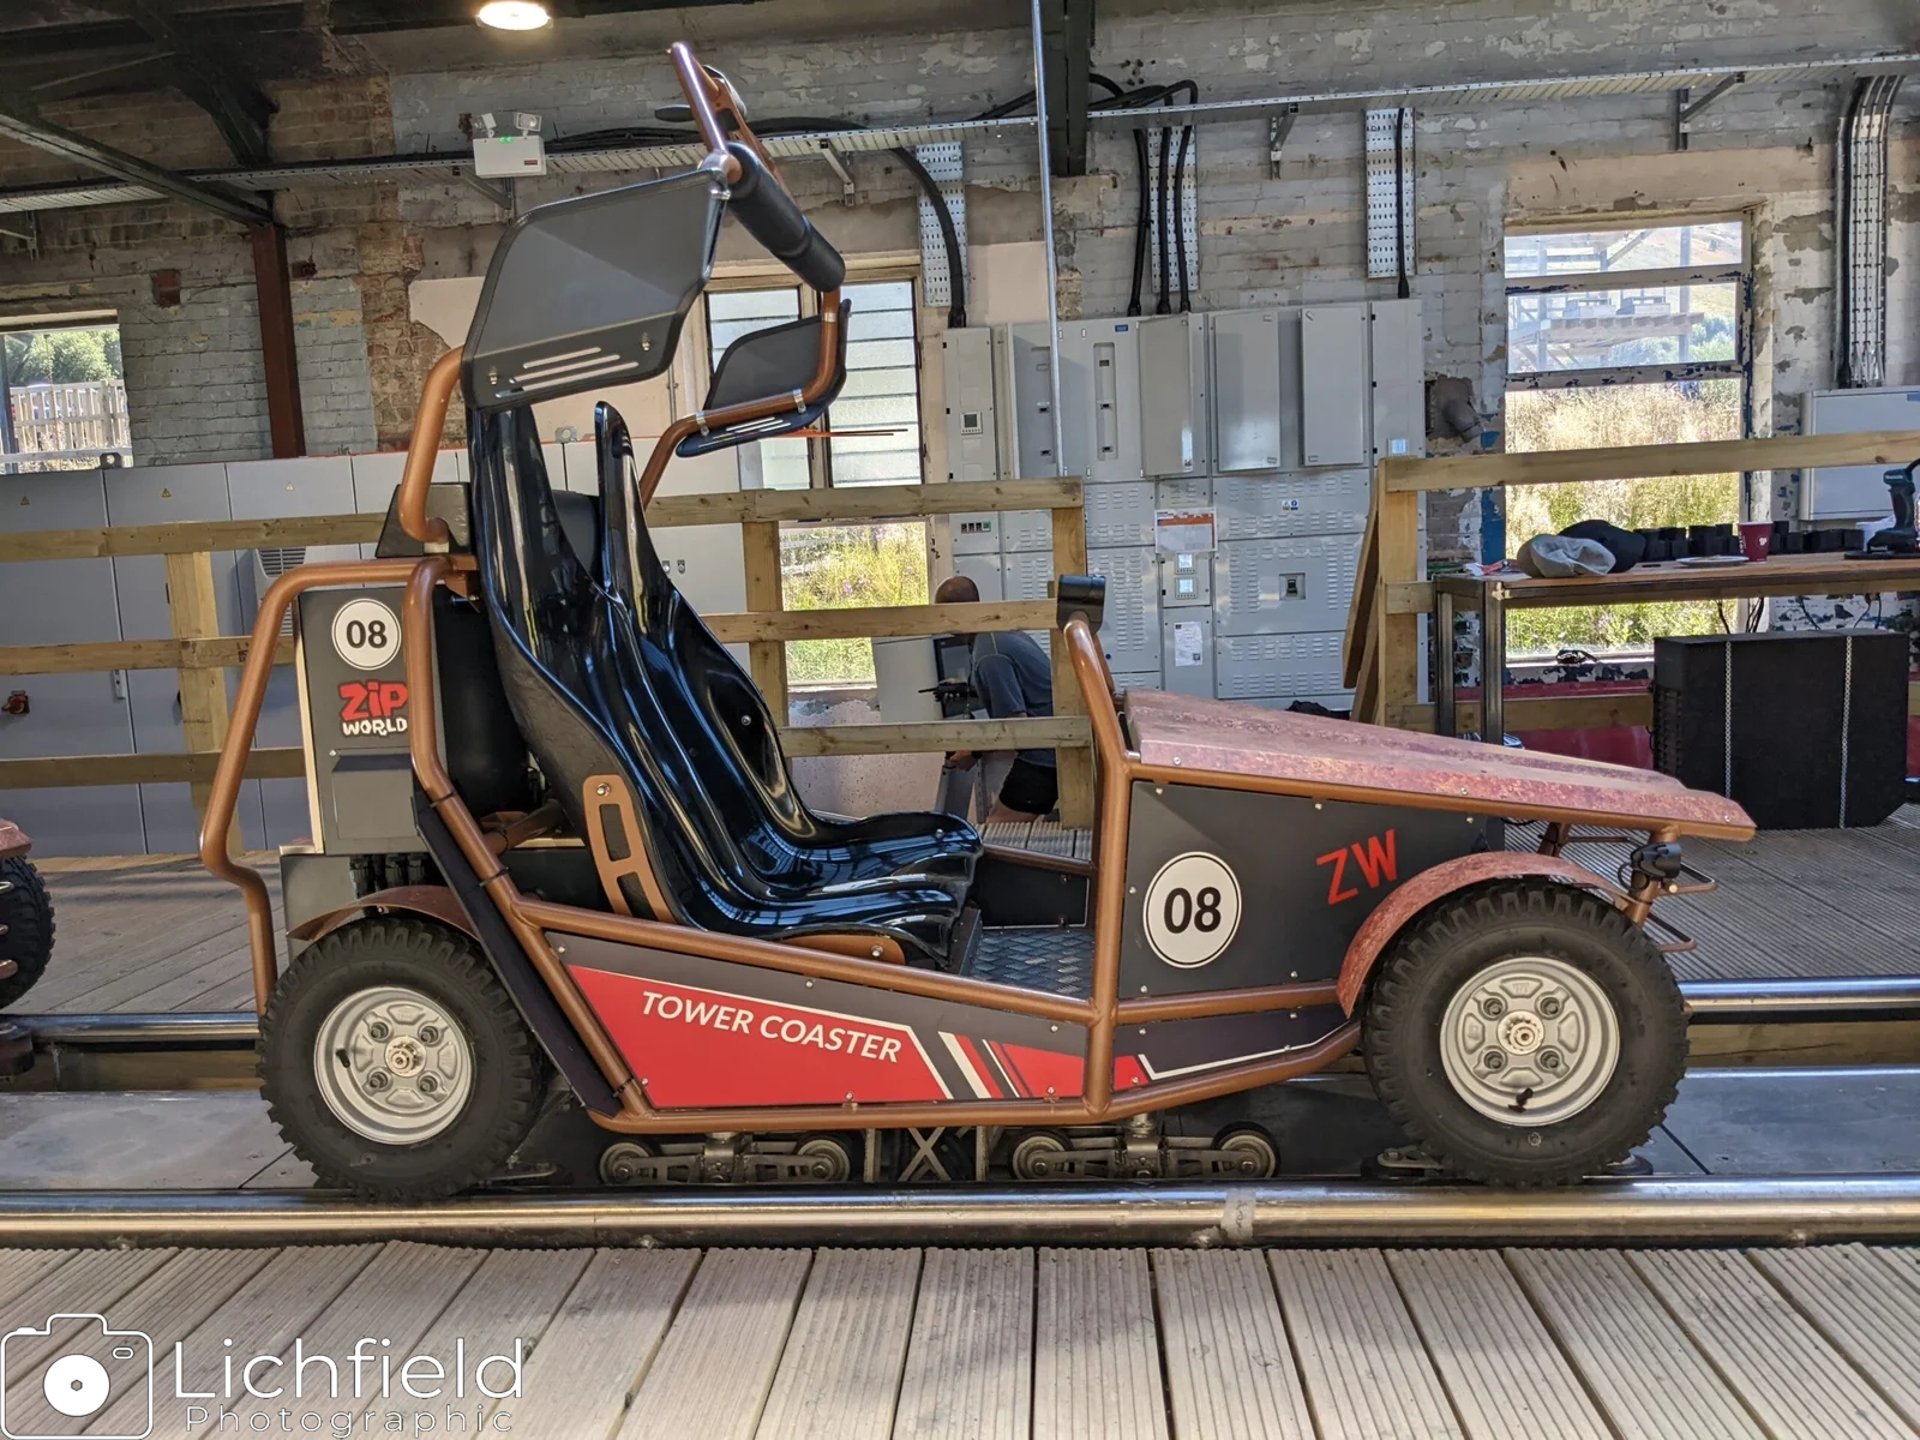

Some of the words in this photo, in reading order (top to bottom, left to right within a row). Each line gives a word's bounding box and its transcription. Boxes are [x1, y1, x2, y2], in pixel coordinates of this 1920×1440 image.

[345, 619, 388, 649] 08
[342, 717, 408, 736] WORLD
[1315, 828, 1398, 906] ZW
[1163, 886, 1222, 935] 08
[642, 990, 755, 1034] TOWER
[759, 1014, 902, 1063] COASTER
